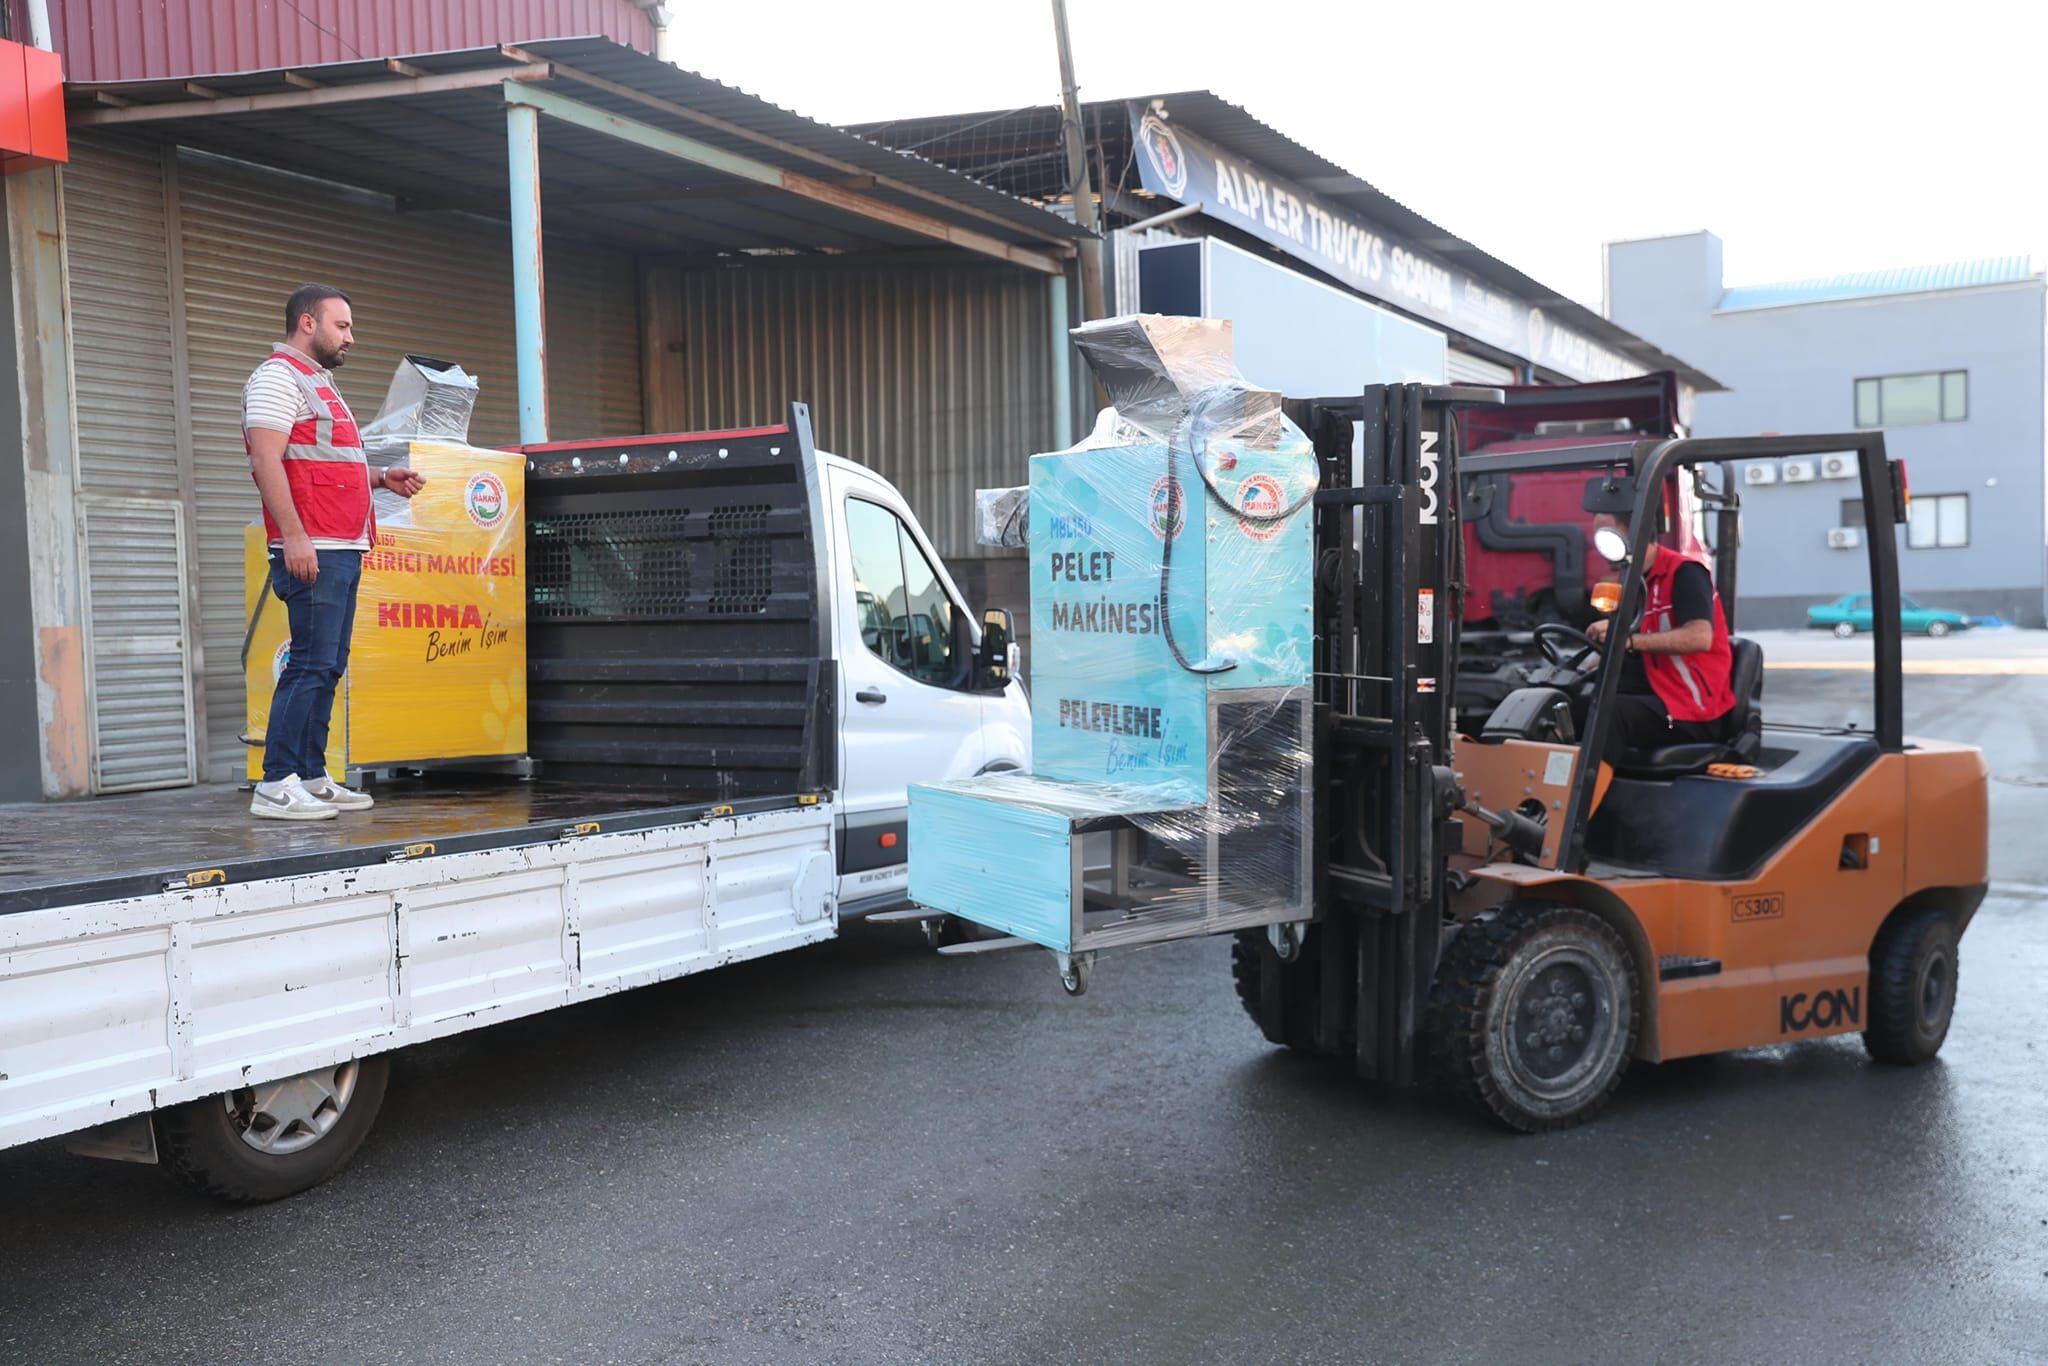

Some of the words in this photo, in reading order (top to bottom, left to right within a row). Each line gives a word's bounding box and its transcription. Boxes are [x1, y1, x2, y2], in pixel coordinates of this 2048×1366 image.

[1215, 158, 1304, 245] ALPLER
[1306, 203, 1384, 281] TRUCKS
[1419, 431, 1439, 524] ICON
[427, 552, 515, 577] MAKİNESİ
[1051, 552, 1114, 582] PELET
[379, 602, 483, 629] KIRMA
[1052, 594, 1159, 635] MAKİNESİ
[426, 630, 471, 664] Benim
[1059, 699, 1161, 740] PELETLEME
[1106, 736, 1149, 775] Benim
[1733, 897, 1781, 917] CS30D
[1780, 986, 1860, 1034] ICON
